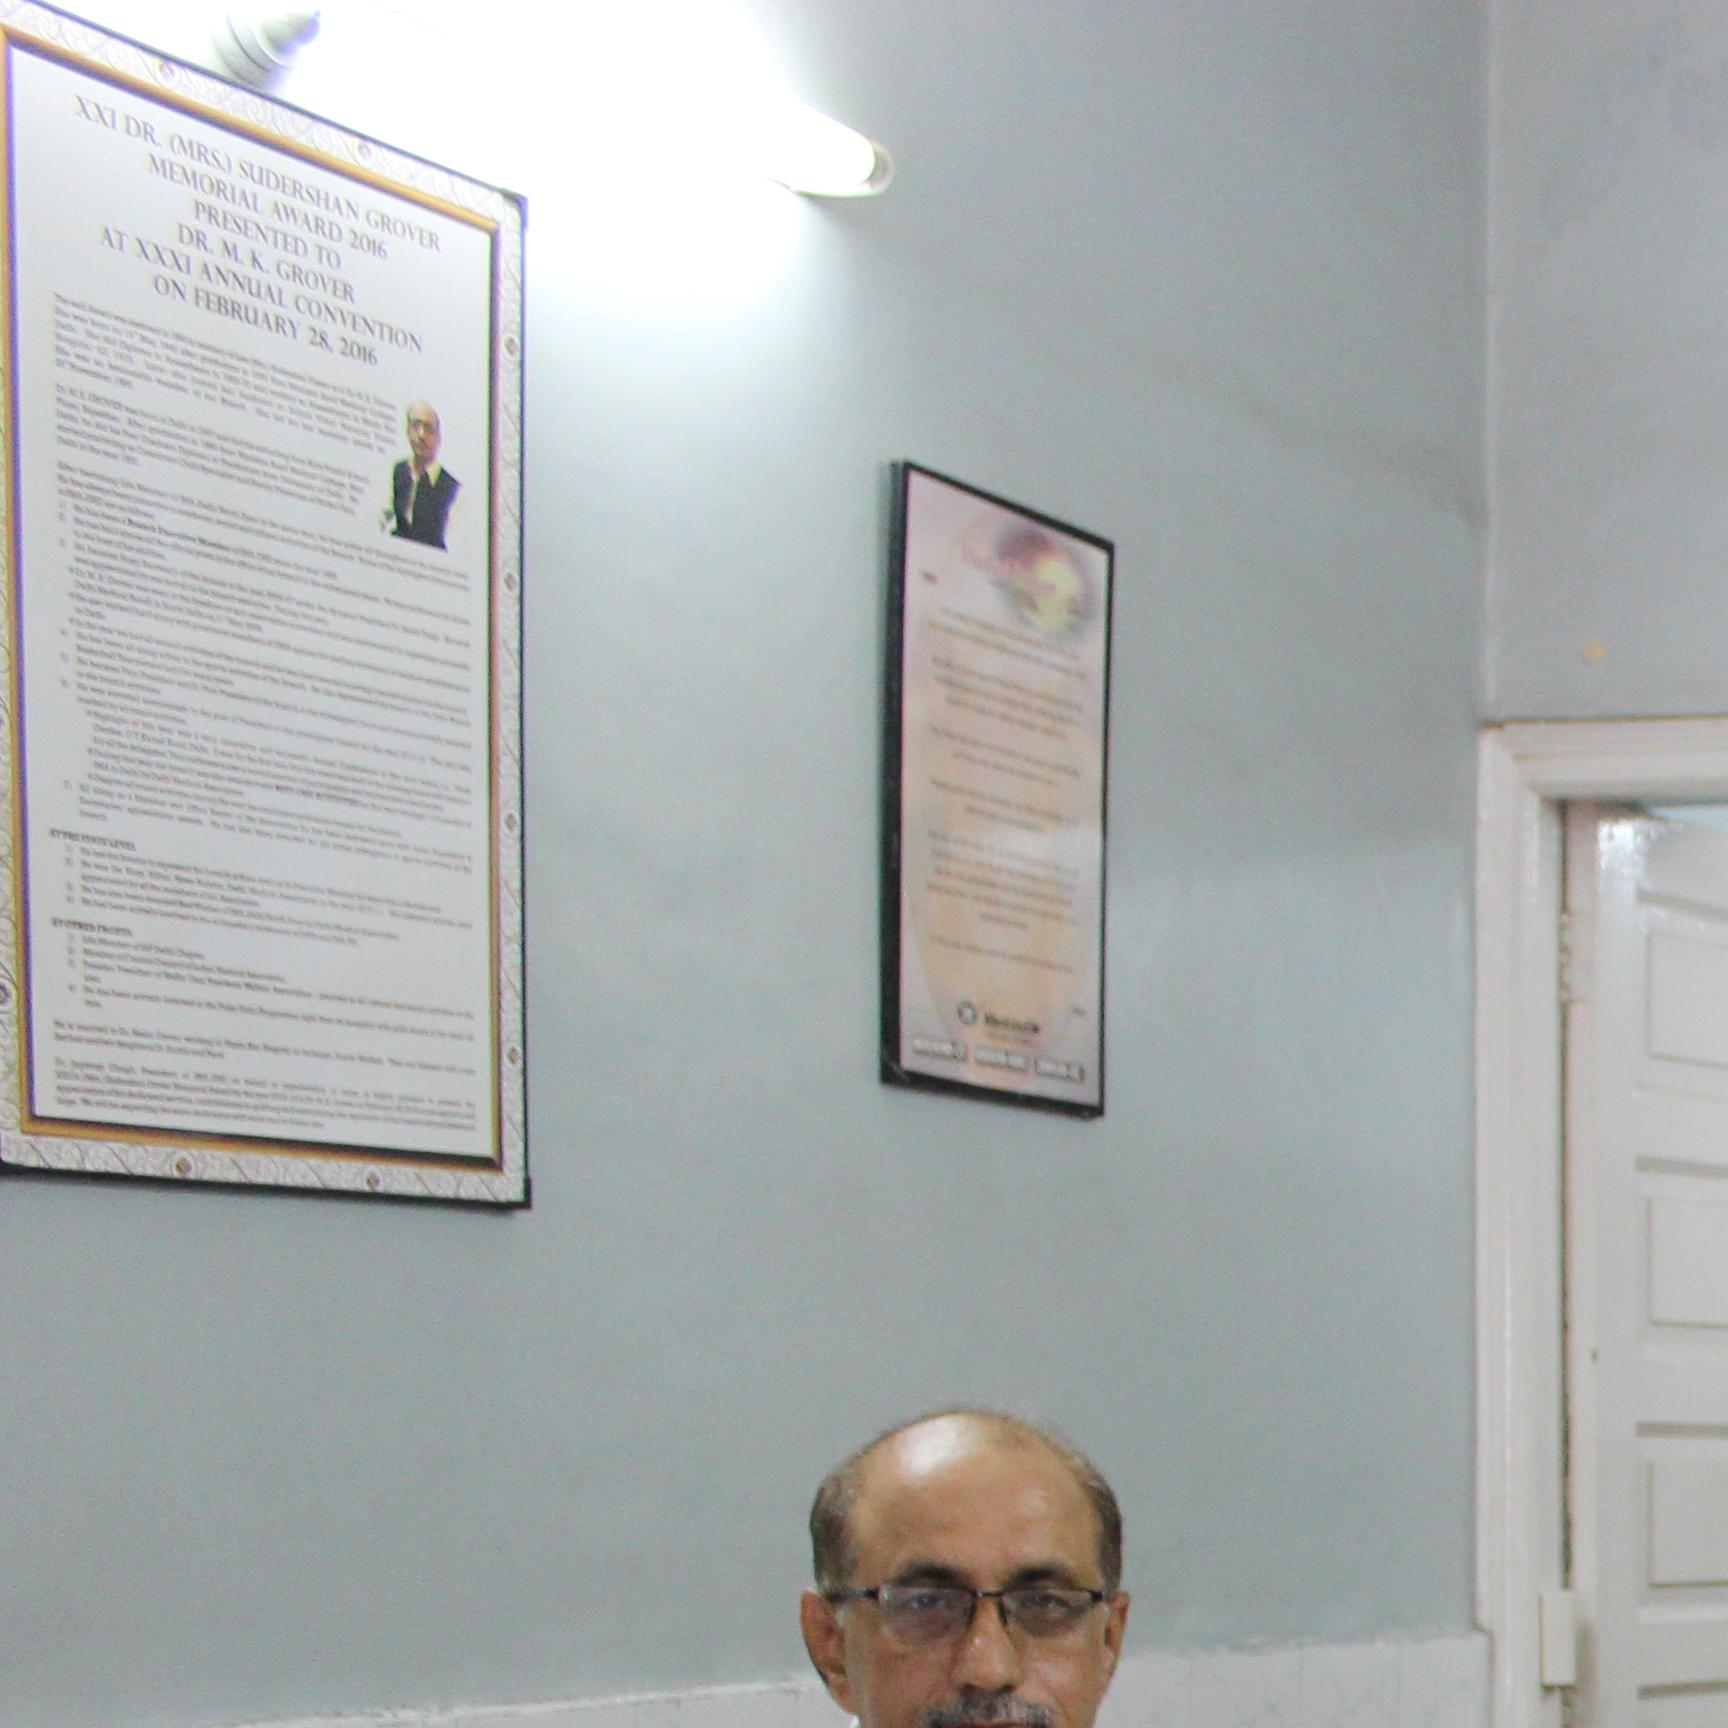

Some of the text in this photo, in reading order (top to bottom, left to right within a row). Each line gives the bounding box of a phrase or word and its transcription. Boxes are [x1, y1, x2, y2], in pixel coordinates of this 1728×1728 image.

[75, 94, 117, 131] XXI
[124, 113, 163, 148] DR.
[239, 159, 359, 220] SUDERSHAN
[366, 208, 440, 252] GROVER
[148, 151, 388, 260] MEMORIAL AWARD 2016
[178, 223, 355, 304] DR. M. K. GROVER
[194, 199, 341, 270] PRESENTED TO
[102, 226, 422, 354] AT XXXI ANNUAL CONVENTION
[154, 274, 378, 366] ON FEBRUARY 28, 2016
